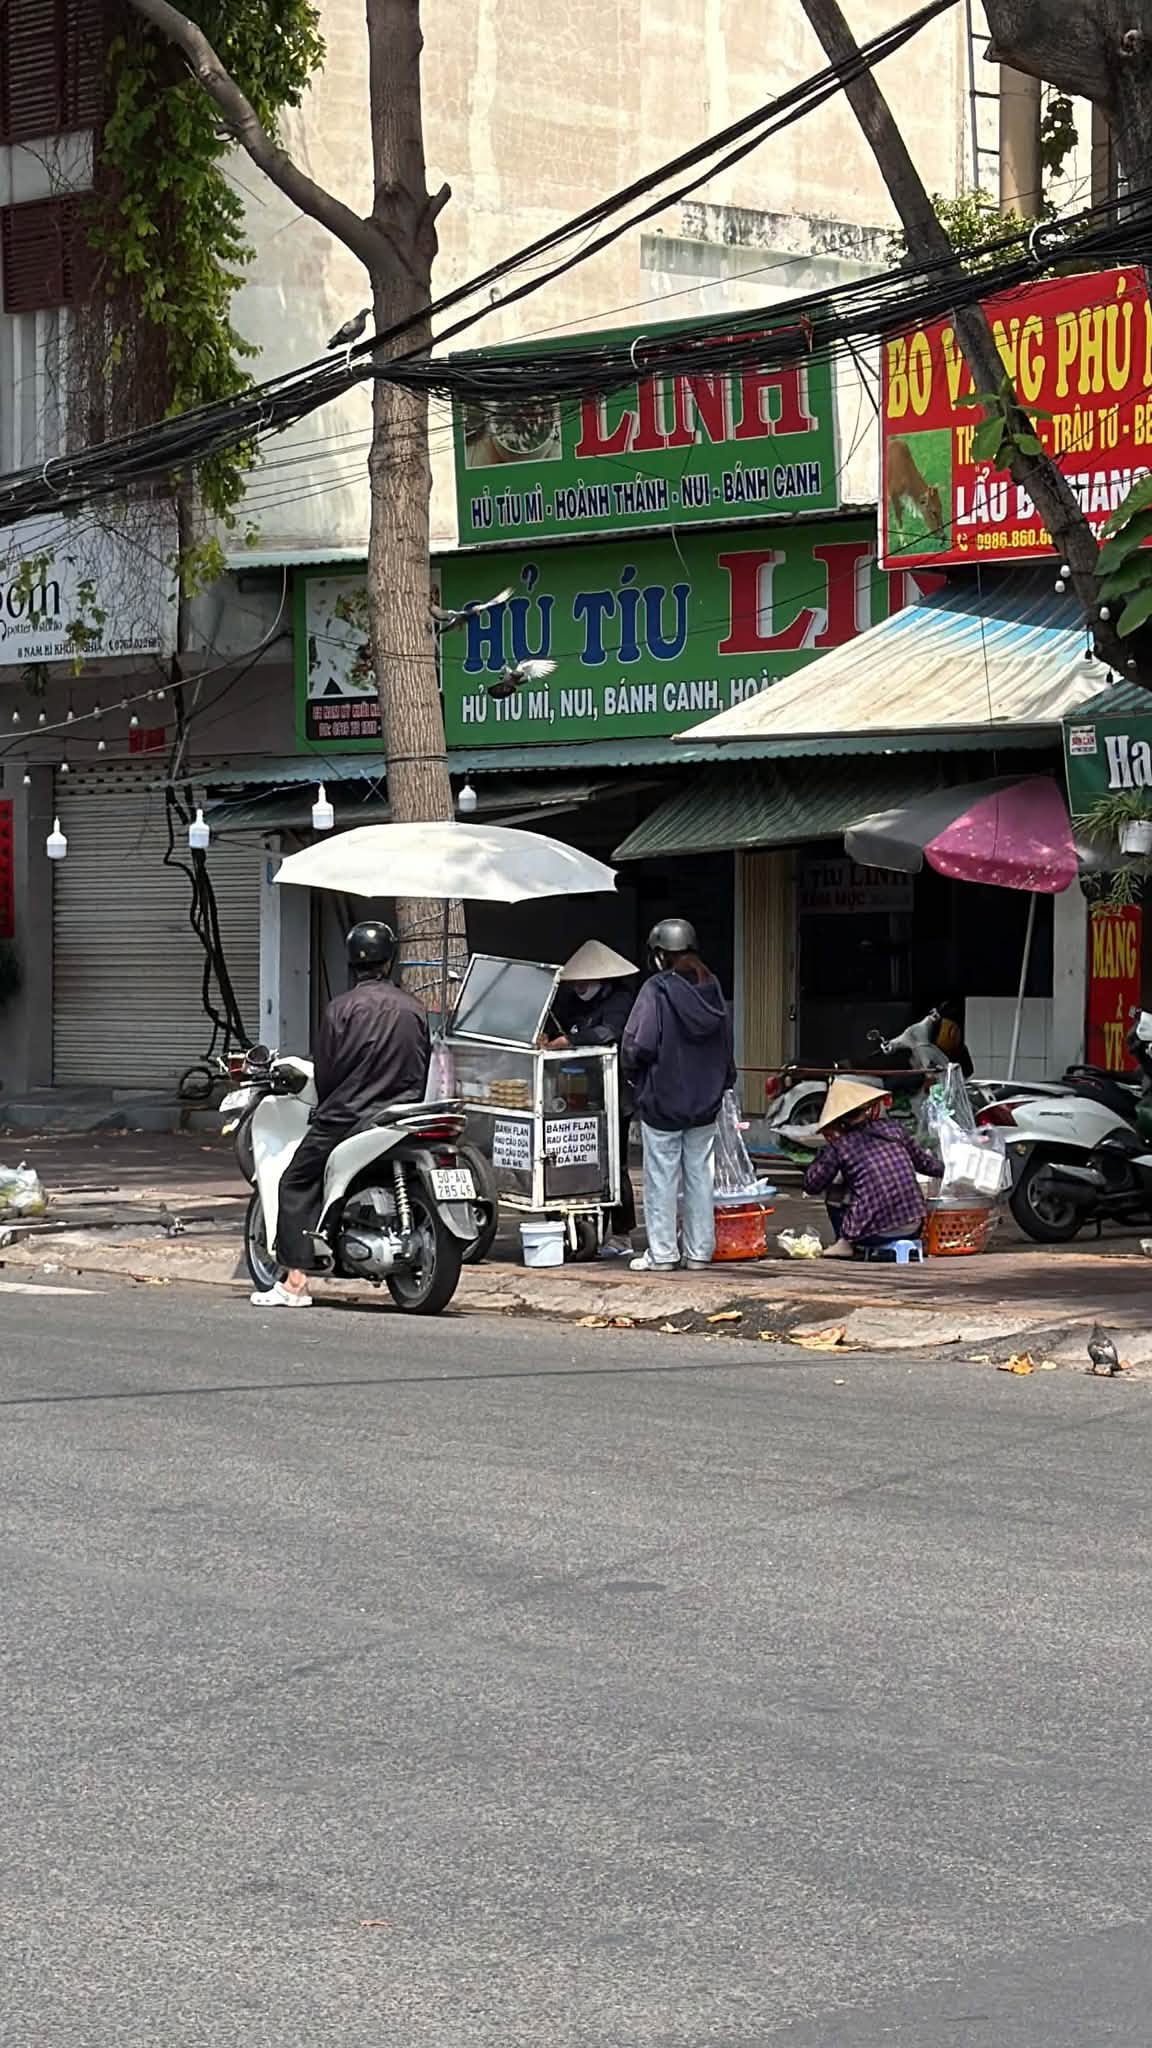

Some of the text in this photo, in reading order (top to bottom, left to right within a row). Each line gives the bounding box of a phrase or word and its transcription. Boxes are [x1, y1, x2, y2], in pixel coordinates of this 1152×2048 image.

[941, 314, 1046, 411] VNG
[1052, 403, 1094, 455] TRÂU
[495, 484, 521, 527] TÍU
[525, 482, 543, 524] MÌ
[555, 476, 610, 520] HOÀNH
[612, 470, 669, 515] THÁNH
[681, 474, 711, 508] NUI
[723, 461, 770, 504] BÁNH
[773, 461, 822, 499] CANH
[462, 562, 555, 674] HỦ
[573, 564, 691, 664] TÍU
[560, 687, 599, 721] NUI,
[604, 677, 657, 715] BÁNH
[1091, 919, 1137, 979] MANG
[572, 1121, 596, 1131] FLAN
